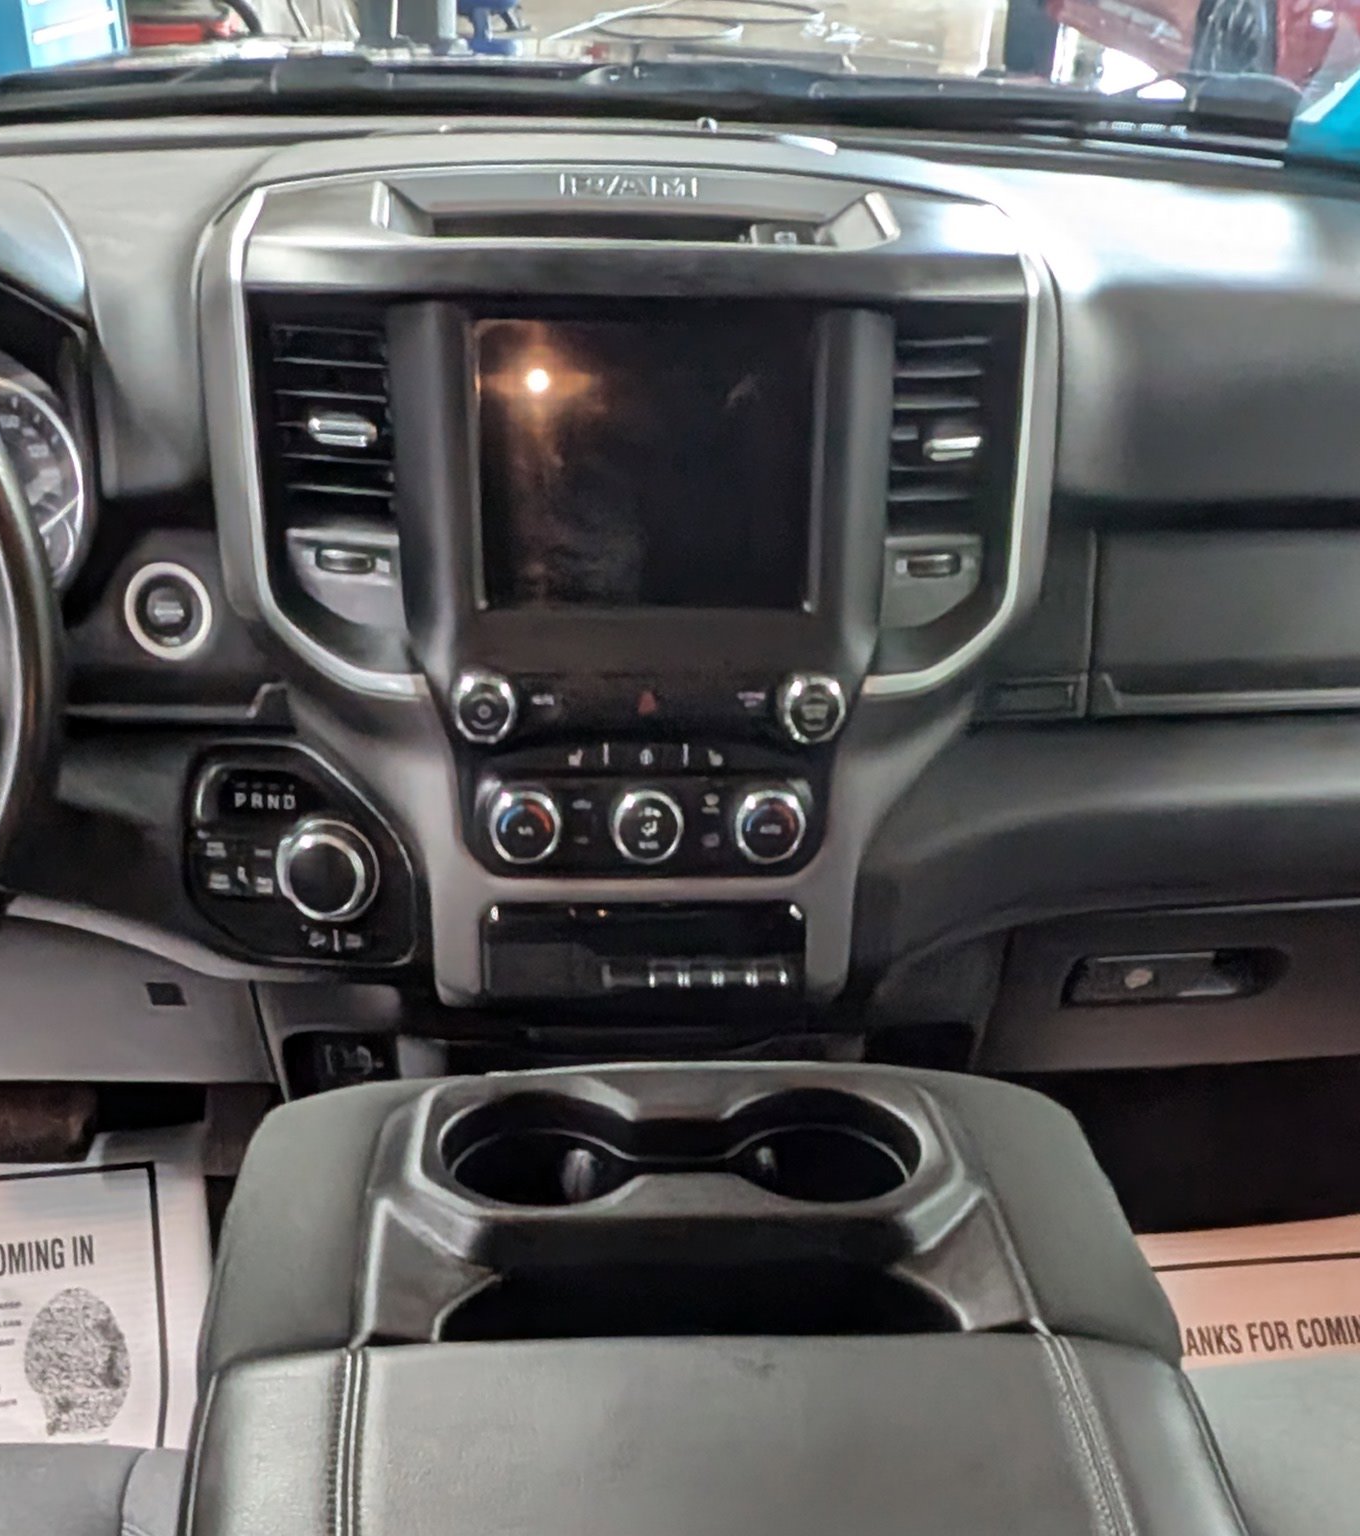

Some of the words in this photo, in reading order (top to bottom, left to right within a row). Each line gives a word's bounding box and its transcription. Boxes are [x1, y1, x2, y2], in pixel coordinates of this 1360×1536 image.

[559, 172, 698, 198] RAM
[72, 1234, 95, 1267] IN
[1184, 1323, 1243, 1357] ANKS
[1246, 1319, 1294, 1352] FOR
